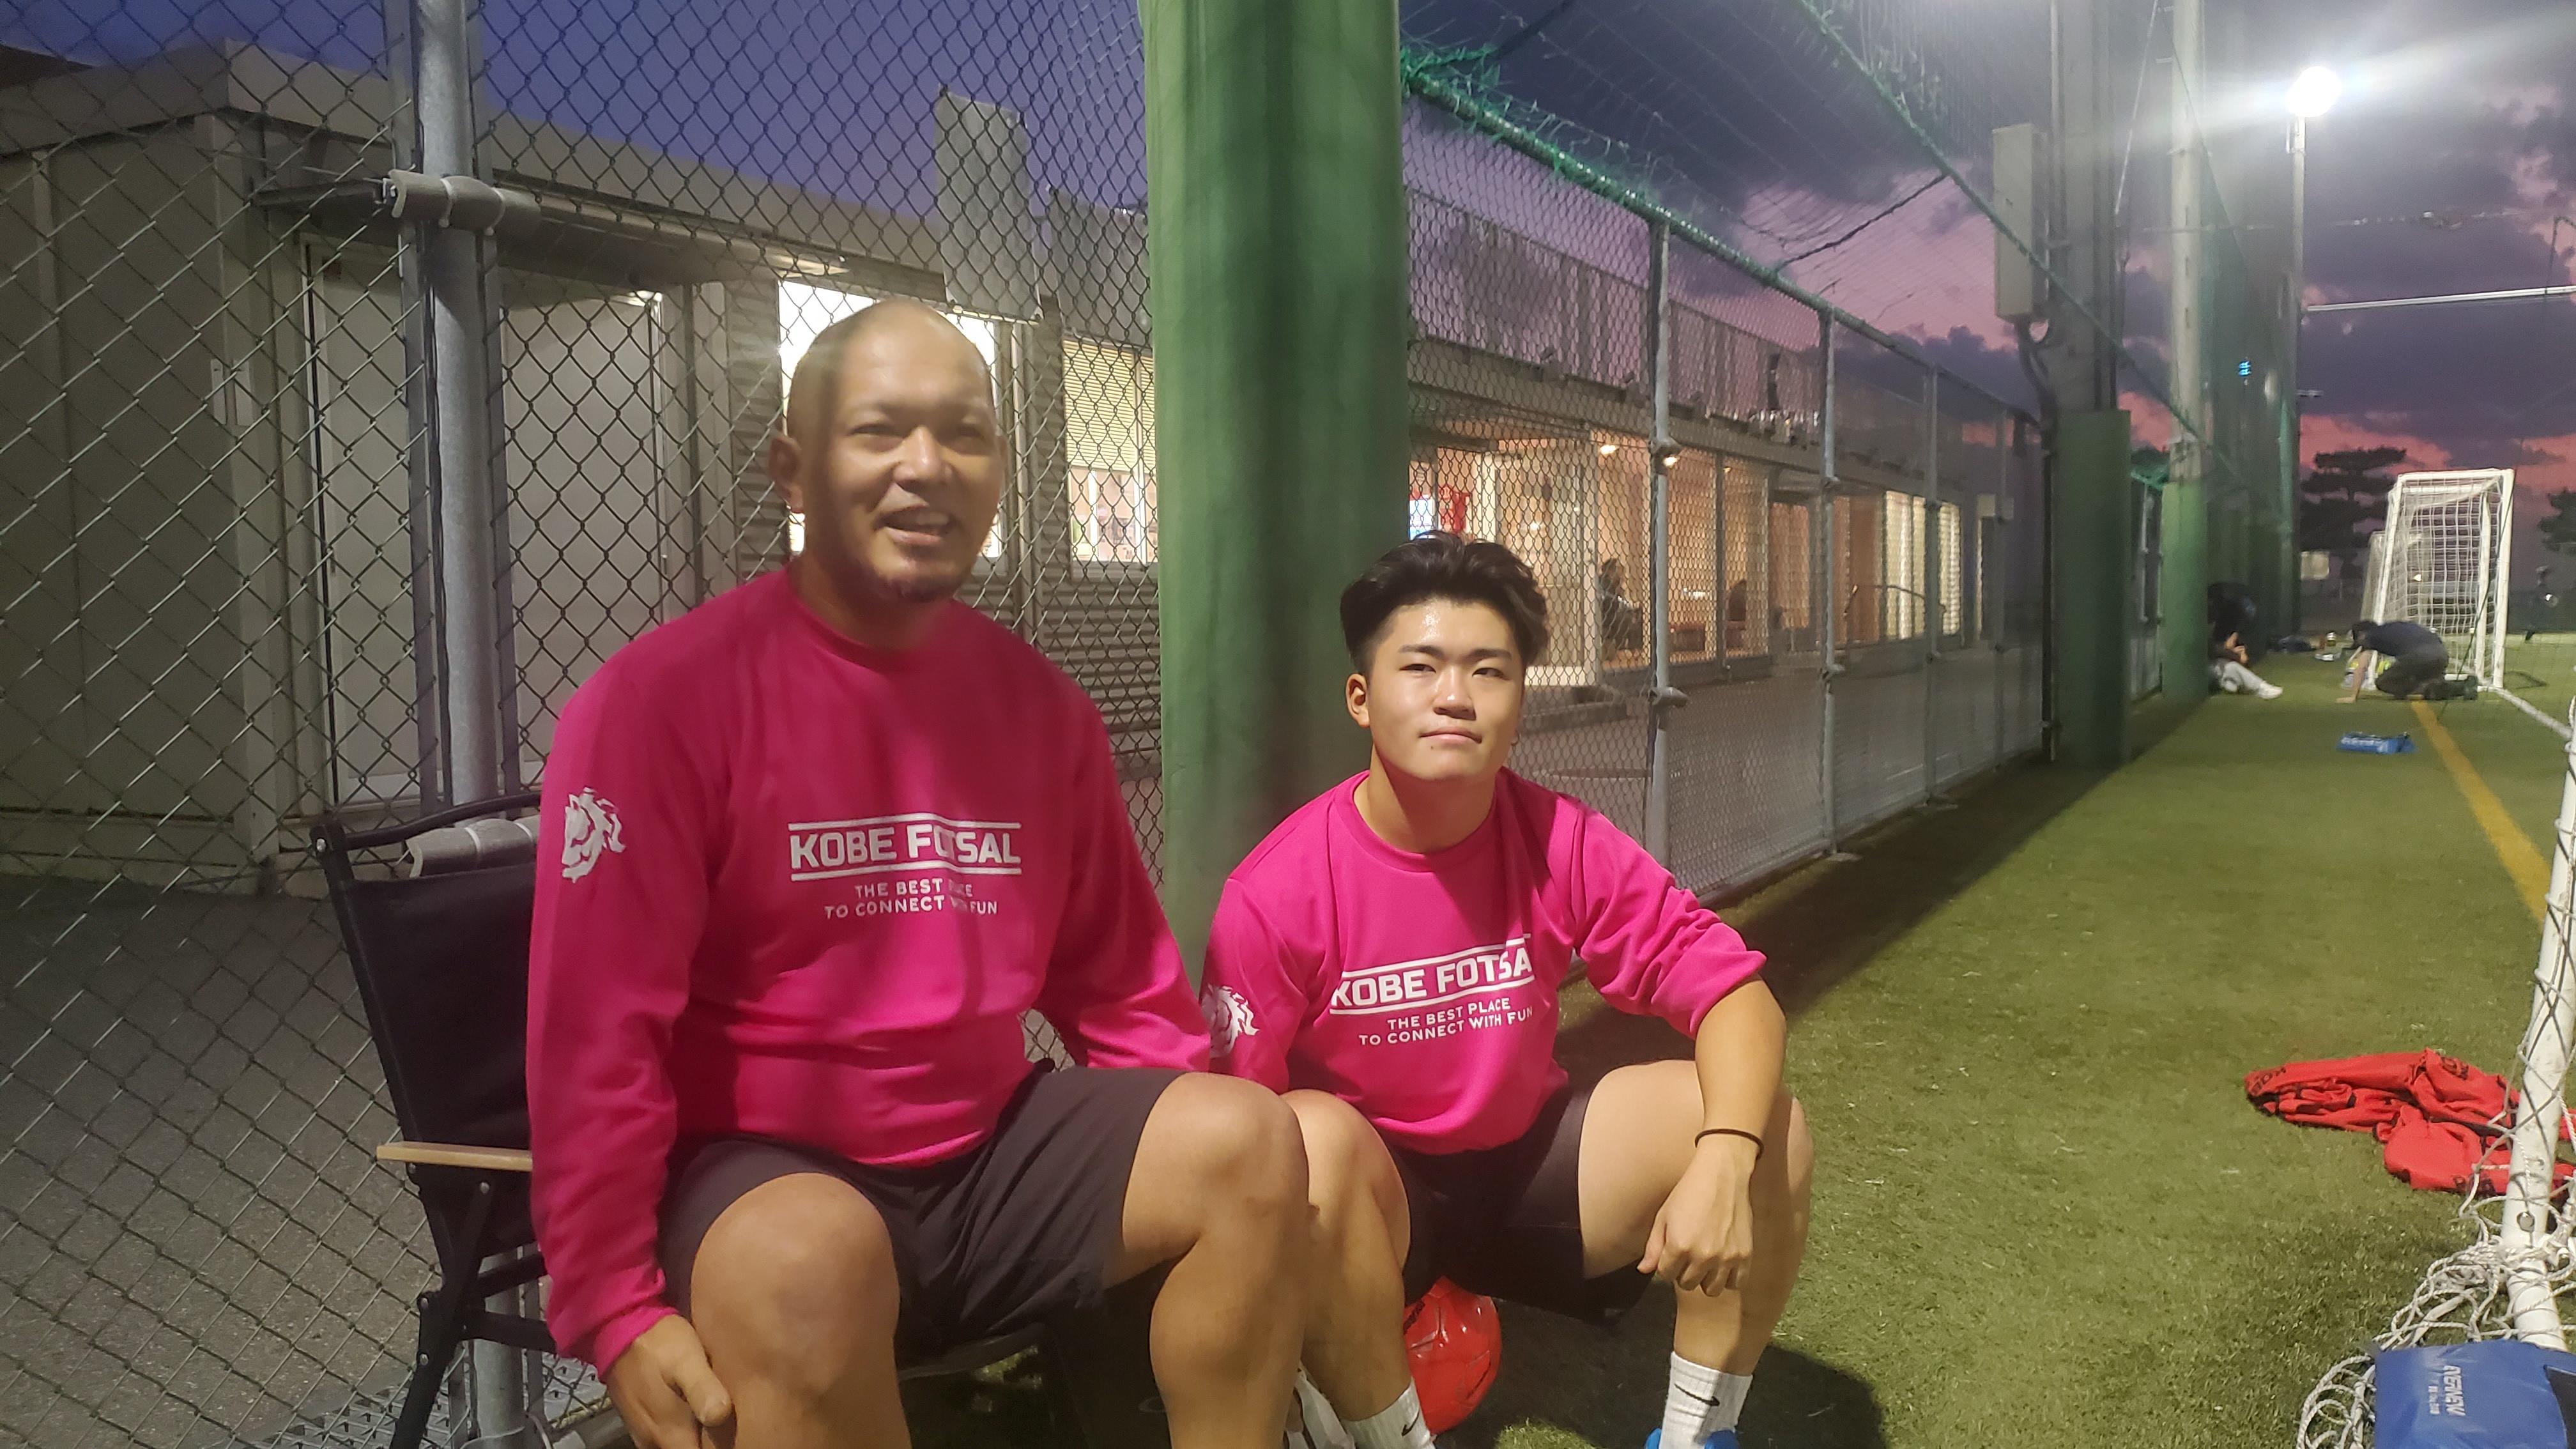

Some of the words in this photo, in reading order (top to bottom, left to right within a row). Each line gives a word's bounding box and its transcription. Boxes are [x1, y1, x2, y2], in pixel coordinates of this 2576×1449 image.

[790, 827, 897, 869] KOBE
[855, 882, 889, 899] THE
[896, 878, 943, 896] BEST
[824, 904, 849, 920] TO
[855, 895, 945, 917] CONNECT
[969, 900, 997, 915] FUN
[1331, 969, 1427, 1007] KOBE
[1436, 947, 1533, 993] FOTSA
[1358, 1034, 1381, 1046] TO
[1387, 1020, 1464, 1044] CONNECT
[1468, 1012, 1502, 1030] WITH
[1507, 1005, 1533, 1025] FUN
[1387, 1015, 1420, 1031] THE
[1426, 1006, 1463, 1025] BEST
[1468, 997, 1511, 1015] PLACE
